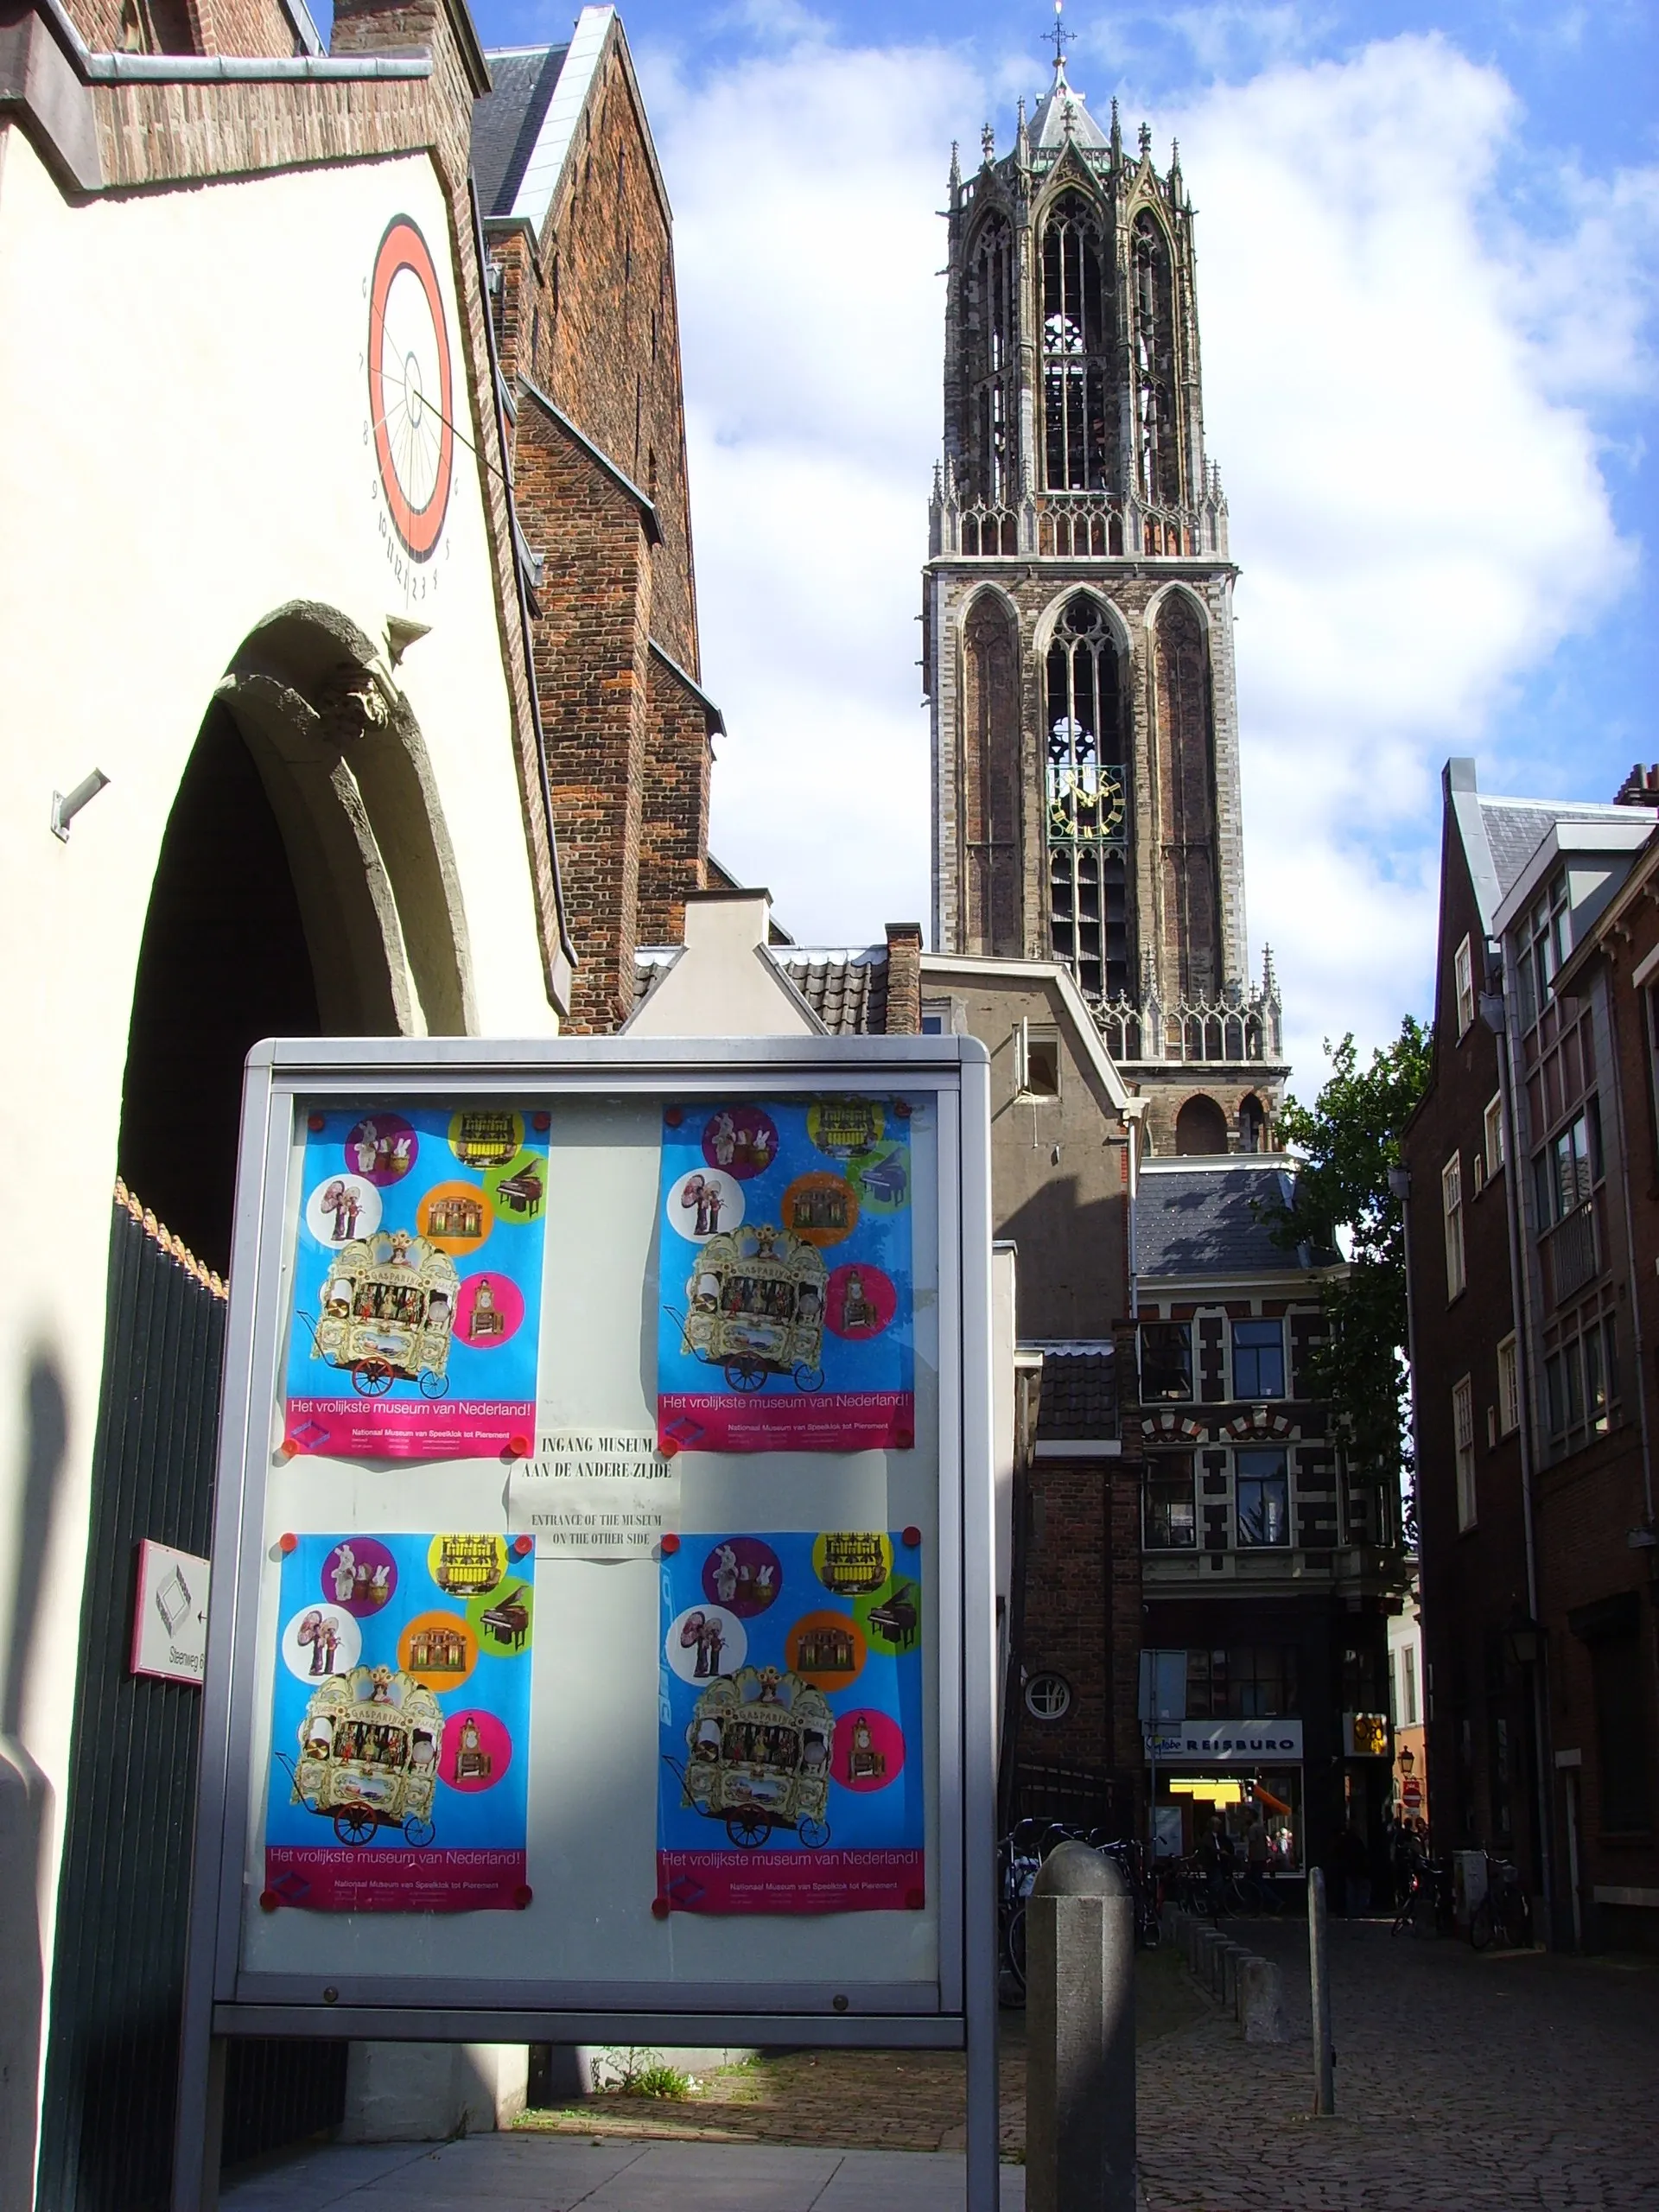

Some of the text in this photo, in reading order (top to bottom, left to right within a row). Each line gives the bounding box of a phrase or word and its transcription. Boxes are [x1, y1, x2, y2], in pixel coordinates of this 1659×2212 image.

[363, 420, 368, 446] 8
[371, 480, 378, 499] 9
[378, 511, 387, 538] 10
[386, 536, 394, 563] 11
[394, 554, 403, 584] 12
[291, 1400, 531, 1416] Het vrolijkste museum van Nederland!
[664, 1394, 908, 1411] Het vrolijkste museum van Nederland!
[429, 1430, 461, 1439] Speelklok
[542, 1437, 652, 1452] INGANG MUSEUM
[522, 1462, 672, 1479] AAN DE ANDERE ZIJDE
[531, 1514, 662, 1527] ENTRANCE OF THE MUSEUM
[553, 1533, 650, 1545] ON THE OTHER SIDE
[169, 1645, 199, 1673] Steenweg
[1186, 1739, 1294, 1751] REISBURO
[270, 1848, 520, 1866] Het vrolijkste museum van Nederland!
[663, 1851, 918, 1869] Het vrolijkste museum van Nederland!
